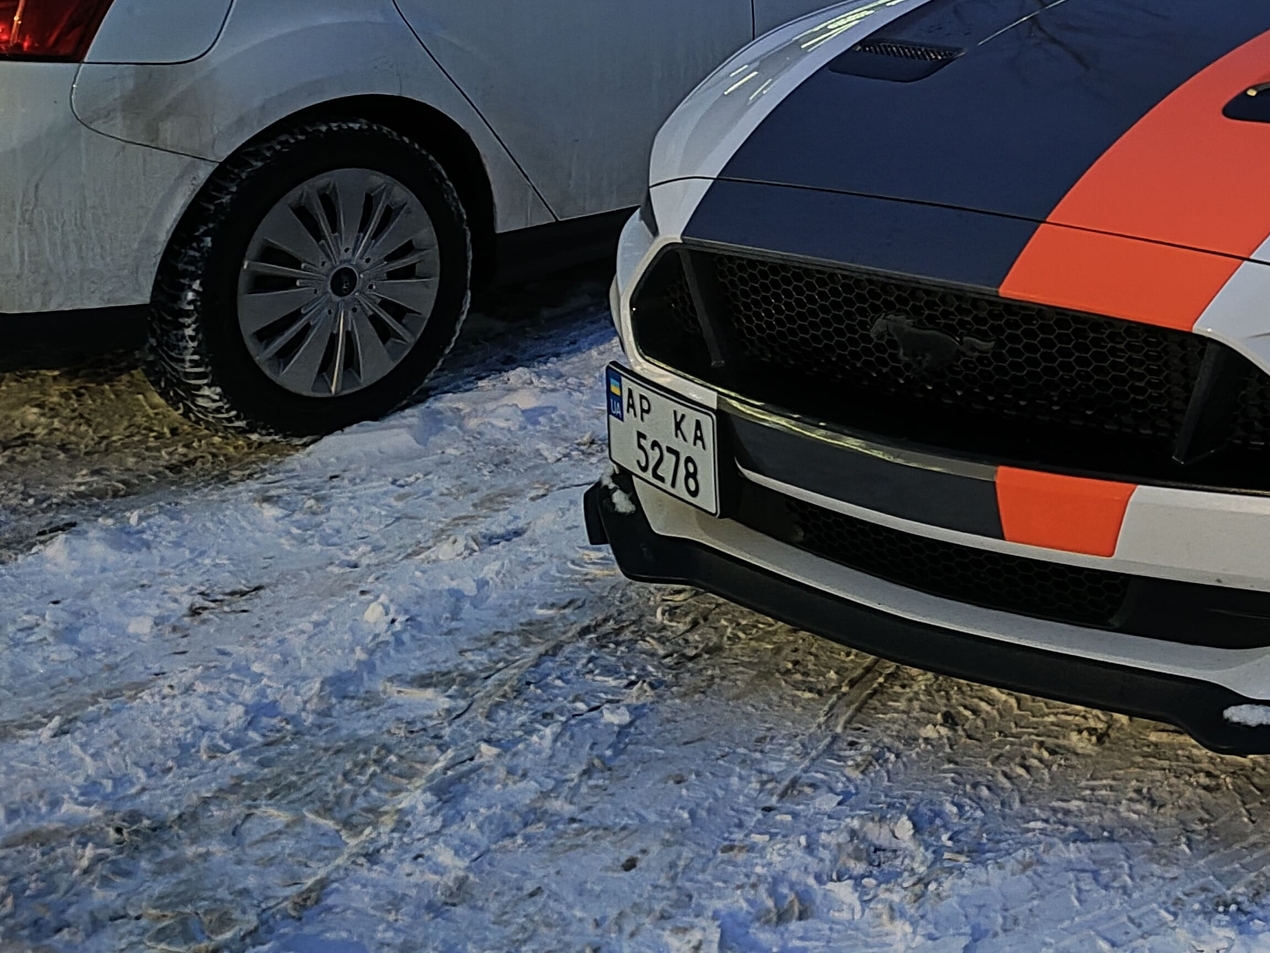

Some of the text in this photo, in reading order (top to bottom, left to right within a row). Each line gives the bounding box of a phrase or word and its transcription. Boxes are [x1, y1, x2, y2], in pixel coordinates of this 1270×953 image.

[610, 399, 622, 418] UA
[627, 387, 706, 450] AP KA
[636, 430, 700, 498] 5278
